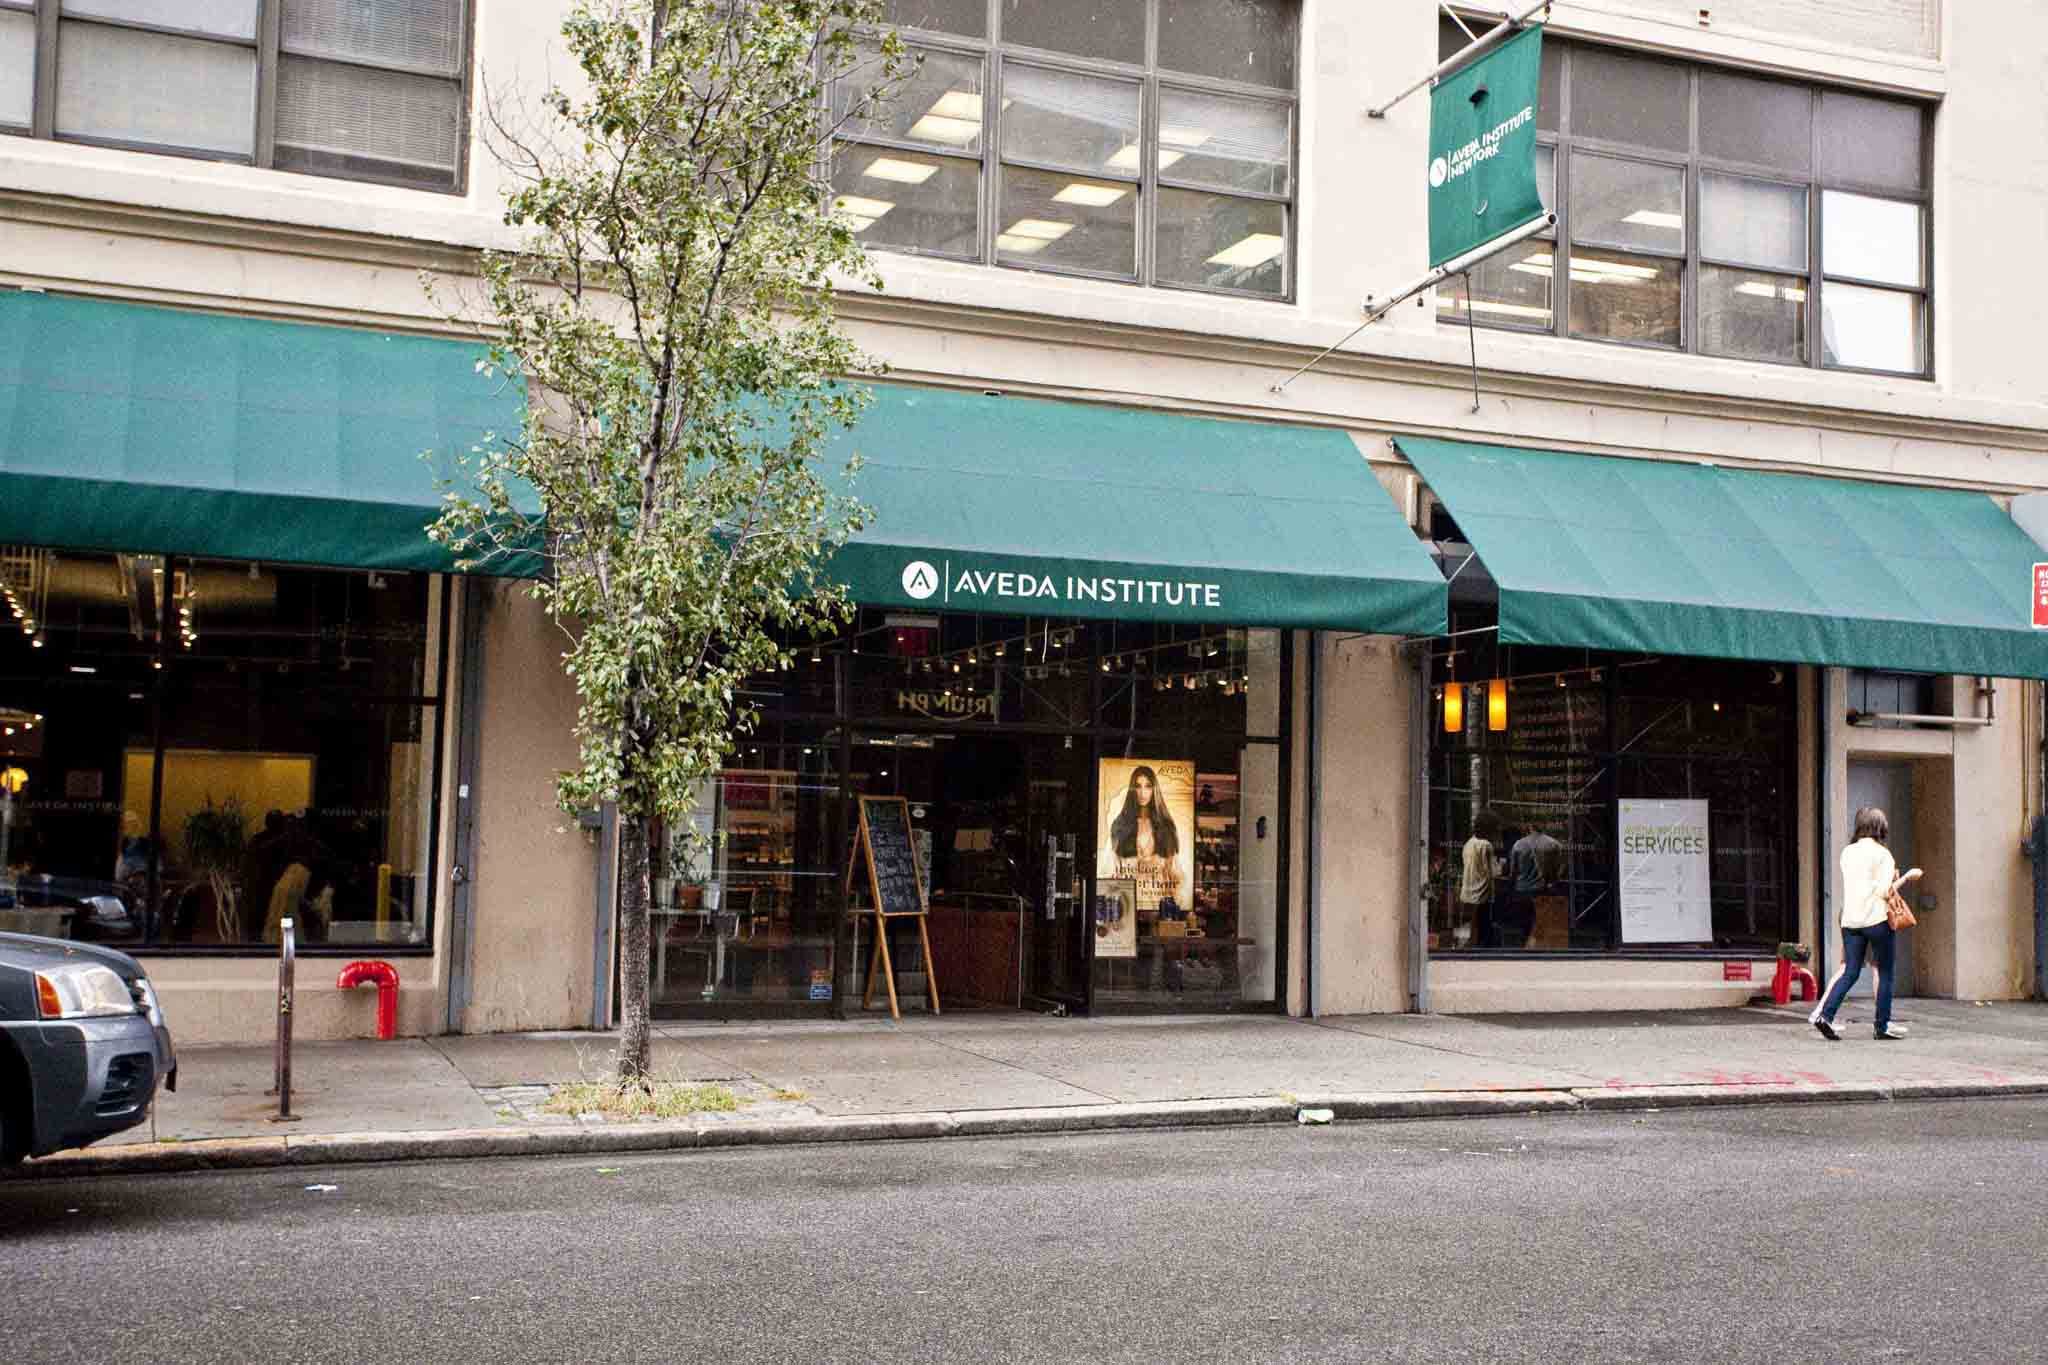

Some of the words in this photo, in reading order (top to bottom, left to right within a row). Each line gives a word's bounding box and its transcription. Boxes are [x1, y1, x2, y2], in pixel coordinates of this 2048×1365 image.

[1451, 138, 1480, 165] AVEDA
[1482, 106, 1533, 147] INSTITUTE
[1451, 159, 1473, 179] NEW
[1473, 142, 1500, 166] YORK
[954, 569, 1058, 599] AVEDA
[1066, 576, 1221, 607] INSTITUTE
[1158, 766, 1191, 776] AVEDA
[1623, 836, 1704, 855] SERVICES
